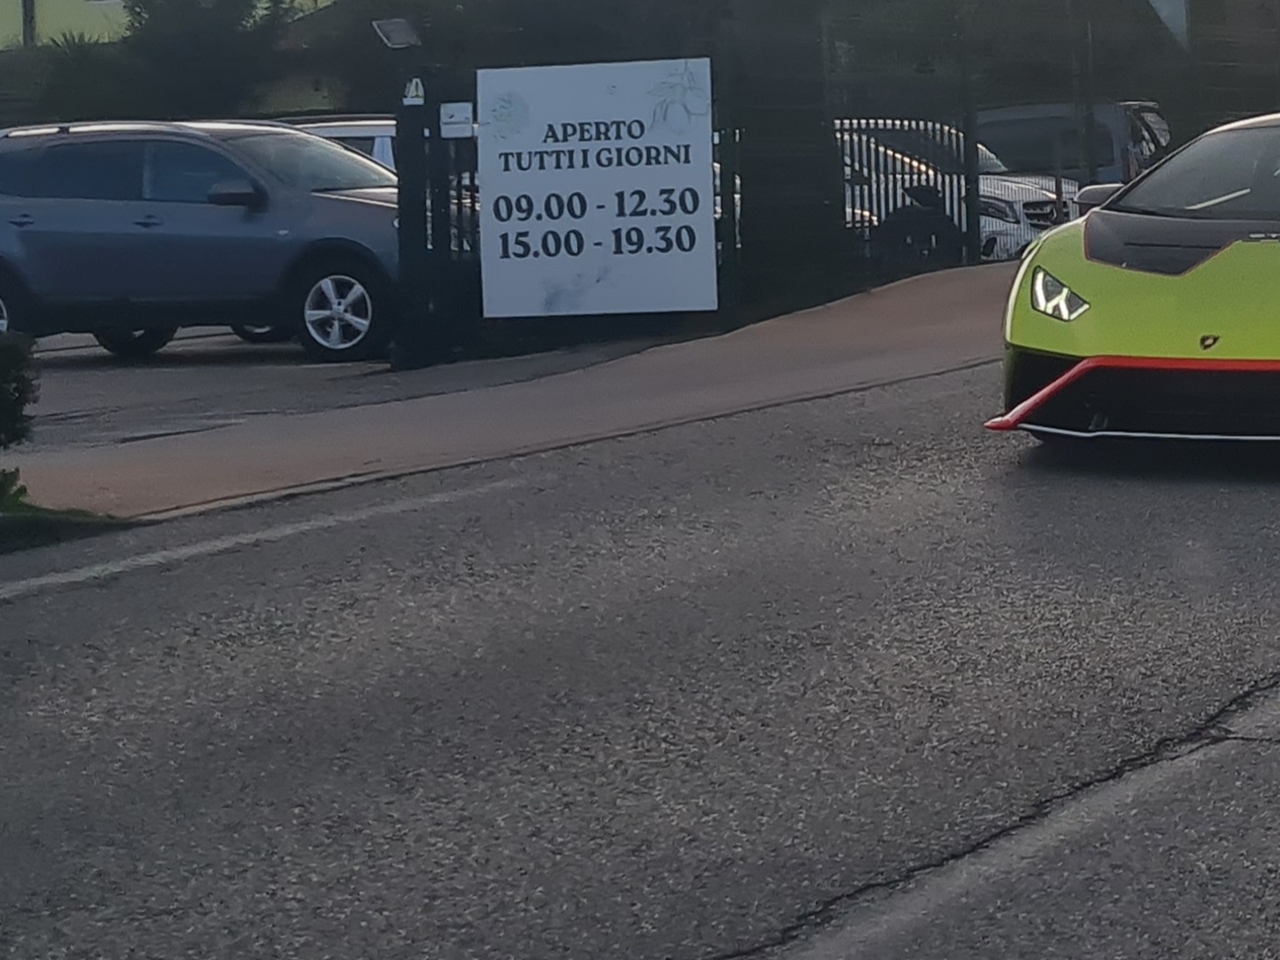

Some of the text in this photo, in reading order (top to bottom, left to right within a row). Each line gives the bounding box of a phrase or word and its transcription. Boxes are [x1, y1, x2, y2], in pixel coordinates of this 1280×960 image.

[543, 120, 645, 143] APERTO
[499, 144, 692, 172] TUTTI I GIORNI
[493, 192, 587, 222] 09.00
[615, 187, 700, 217] 12.30
[499, 229, 584, 259] 15.00
[612, 225, 696, 255] 19.30
